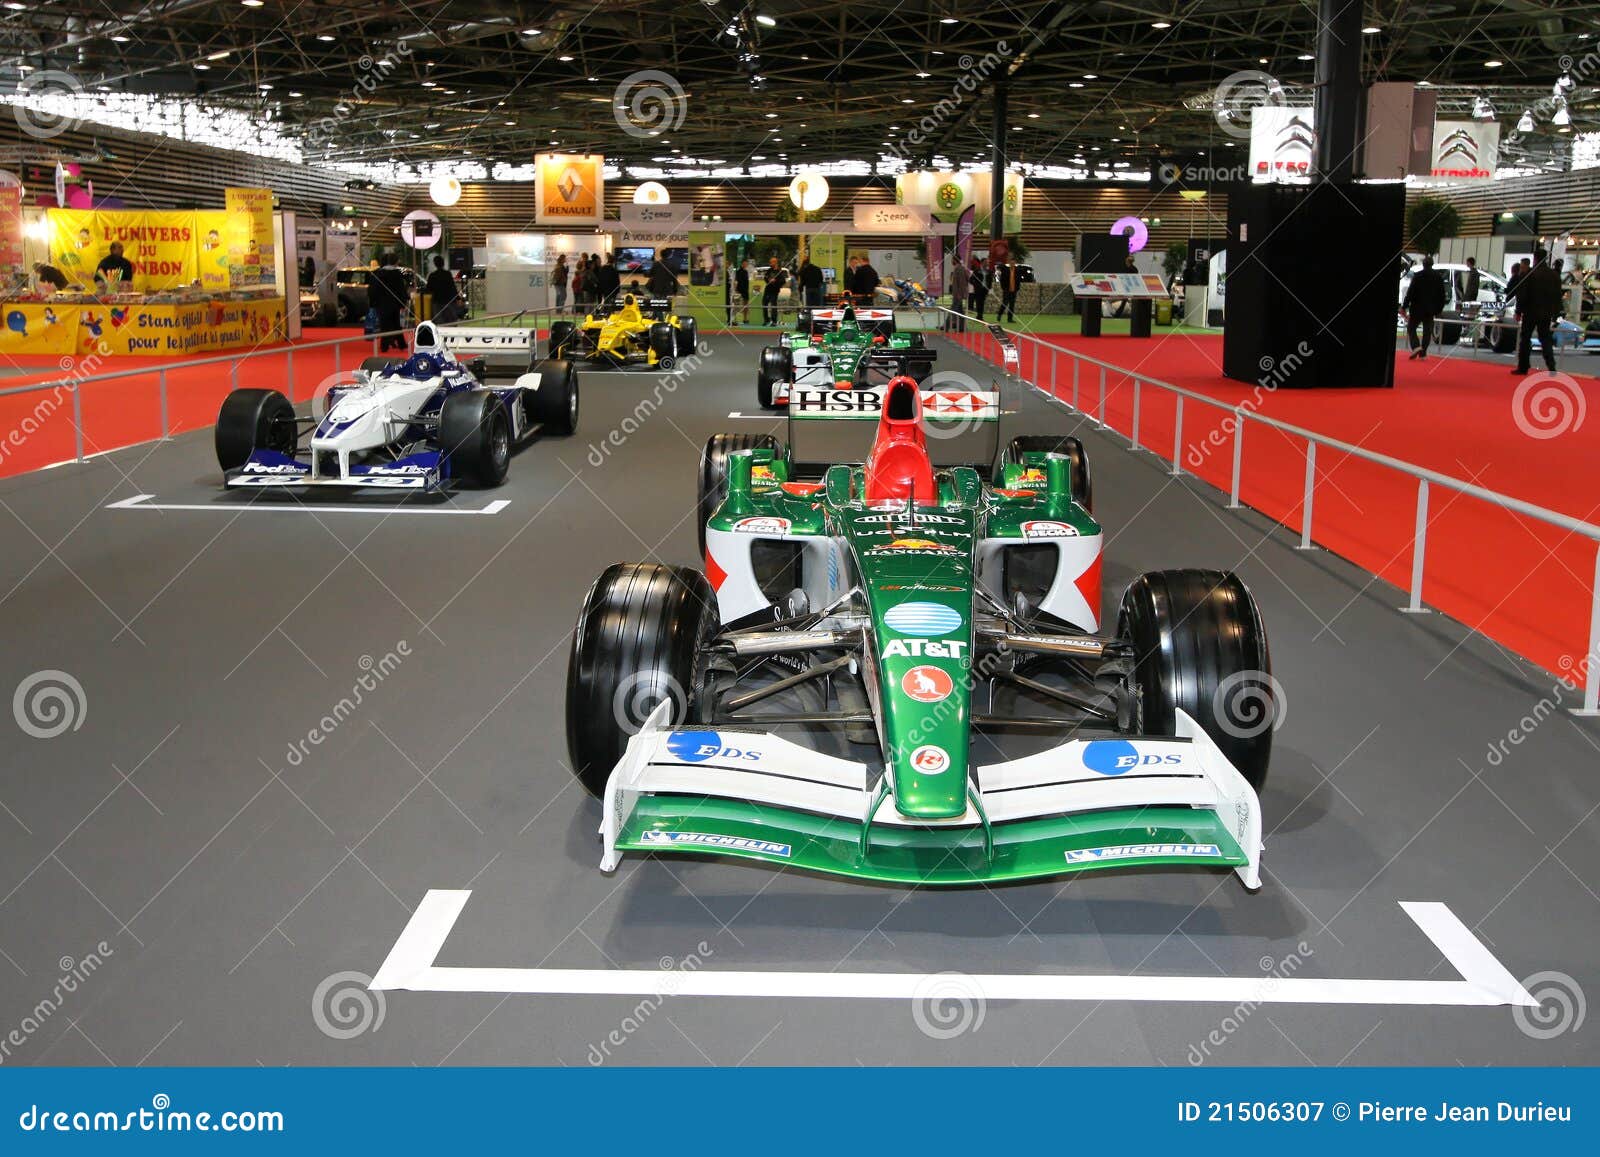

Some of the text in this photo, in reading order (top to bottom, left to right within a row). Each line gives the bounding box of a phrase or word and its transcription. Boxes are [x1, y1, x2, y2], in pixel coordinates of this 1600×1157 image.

[1185, 164, 1244, 181] smart
[548, 206, 592, 215] RENAULT
[104, 227, 191, 242] L'UNIVERS
[131, 261, 183, 276] ONBON
[128, 337, 160, 352] pour
[797, 391, 882, 411] HSB
[881, 638, 967, 659] AT&T
[694, 744, 761, 761] EDS
[1115, 754, 1182, 768] EDS
[675, 832, 784, 853] MICHELIN
[1099, 844, 1213, 857] MICHELIN
